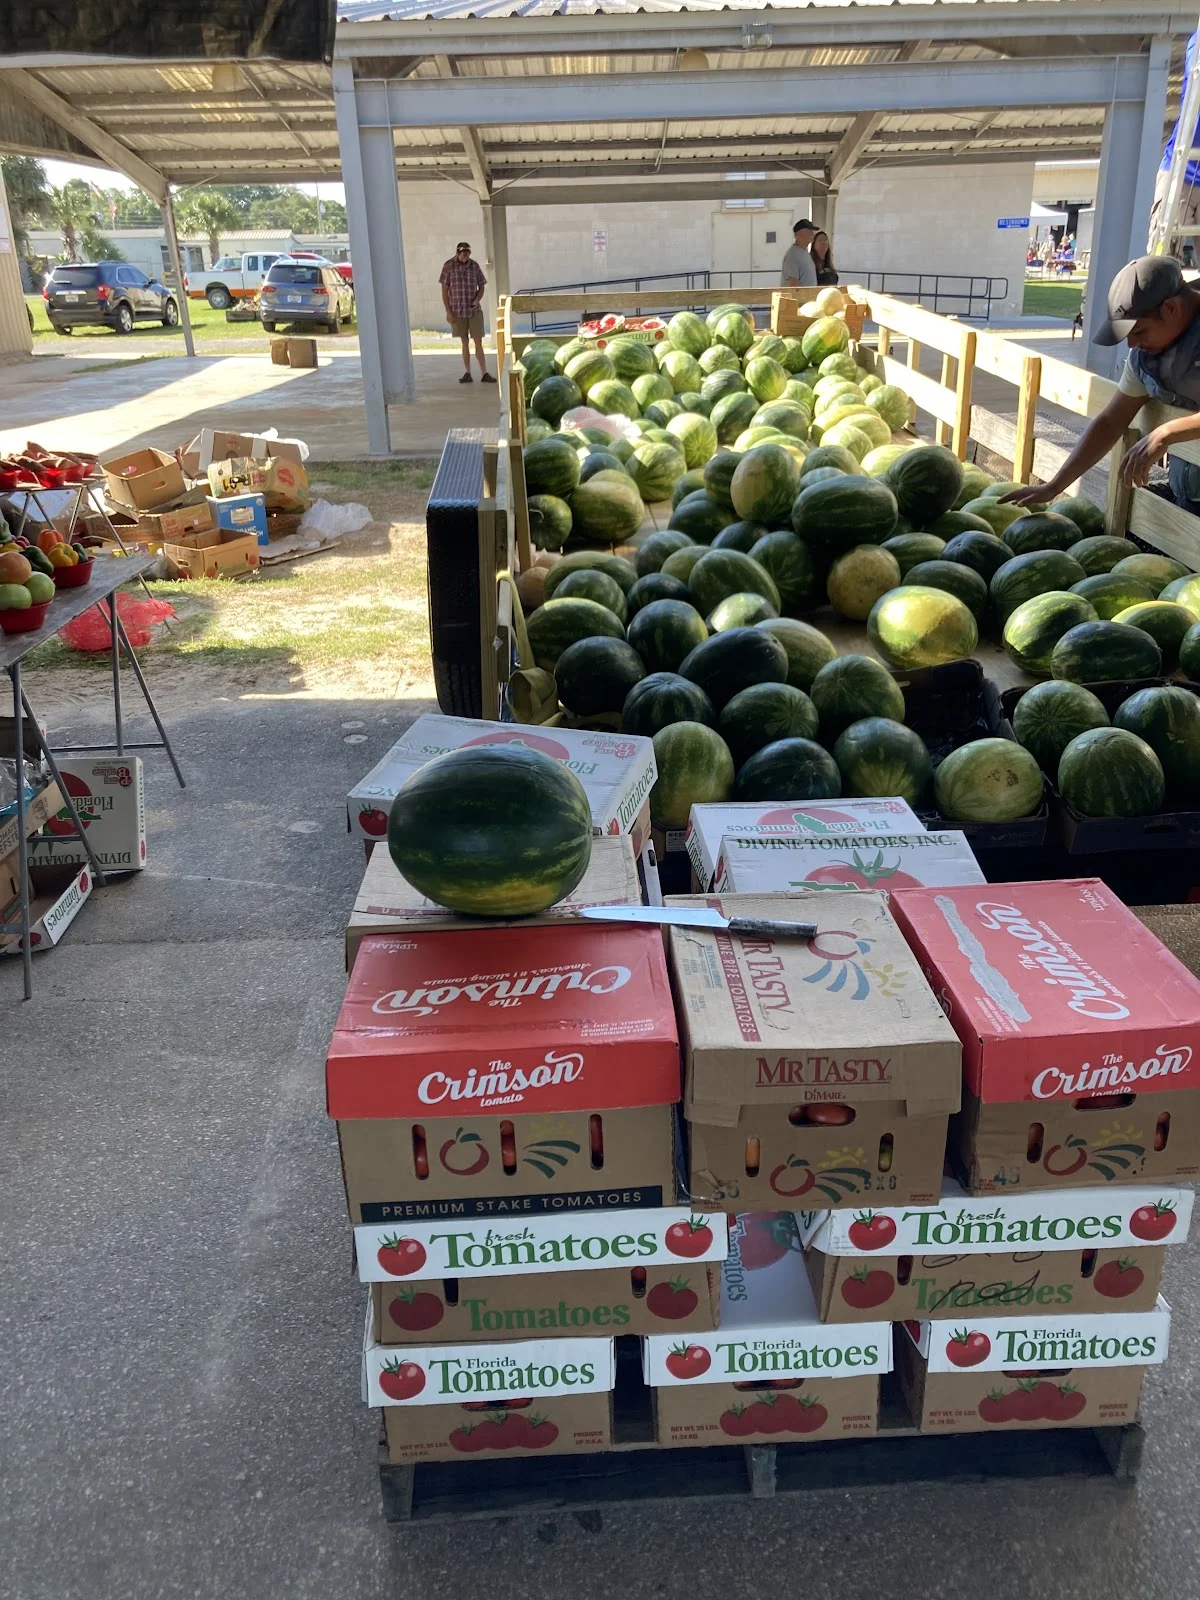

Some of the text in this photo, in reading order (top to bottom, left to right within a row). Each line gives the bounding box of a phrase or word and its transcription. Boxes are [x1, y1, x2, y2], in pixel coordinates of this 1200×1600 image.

[563, 760, 600, 775] Flor
[368, 786, 399, 797] NC.
[617, 761, 654, 832] Tomatoes
[736, 834, 957, 849] DIVINE TOMATOES, INC.
[47, 885, 82, 931] Tomatoes
[531, 962, 592, 976] America's
[976, 901, 1131, 1020] Crimson
[1018, 953, 1040, 970] The
[422, 976, 468, 986] tomato
[469, 971, 511, 982] slicing
[715, 934, 757, 1035] VINE RIPE TOMATOES
[752, 956, 795, 1015] TASTY
[371, 965, 632, 1018] Crimson
[487, 997, 522, 1008] The
[489, 1060, 511, 1072] The
[1102, 1053, 1124, 1065] The
[418, 1051, 583, 1104] Crimson
[756, 1057, 891, 1084] MR TASTY
[1031, 1044, 1193, 1099] Crimson
[480, 1094, 524, 1107] tomato
[1091, 1086, 1133, 1097] tomato
[382, 1191, 642, 1217] PREMIUM STAKE TOMATOES
[902, 1210, 1122, 1245] Tomatoes
[956, 1208, 1007, 1225] fresh
[484, 1227, 536, 1246] fresh
[429, 1232, 658, 1269] Tomatoes
[912, 1278, 1074, 1310] Tomatoes
[462, 1297, 631, 1333] Tomatoes
[753, 1339, 802, 1350] Florida
[1032, 1328, 1082, 1340] Florida
[715, 1341, 878, 1374] Tomatoes
[996, 1329, 1157, 1364] Tomatoes
[466, 1356, 517, 1369] Florida
[428, 1358, 595, 1394] Tomatoes
